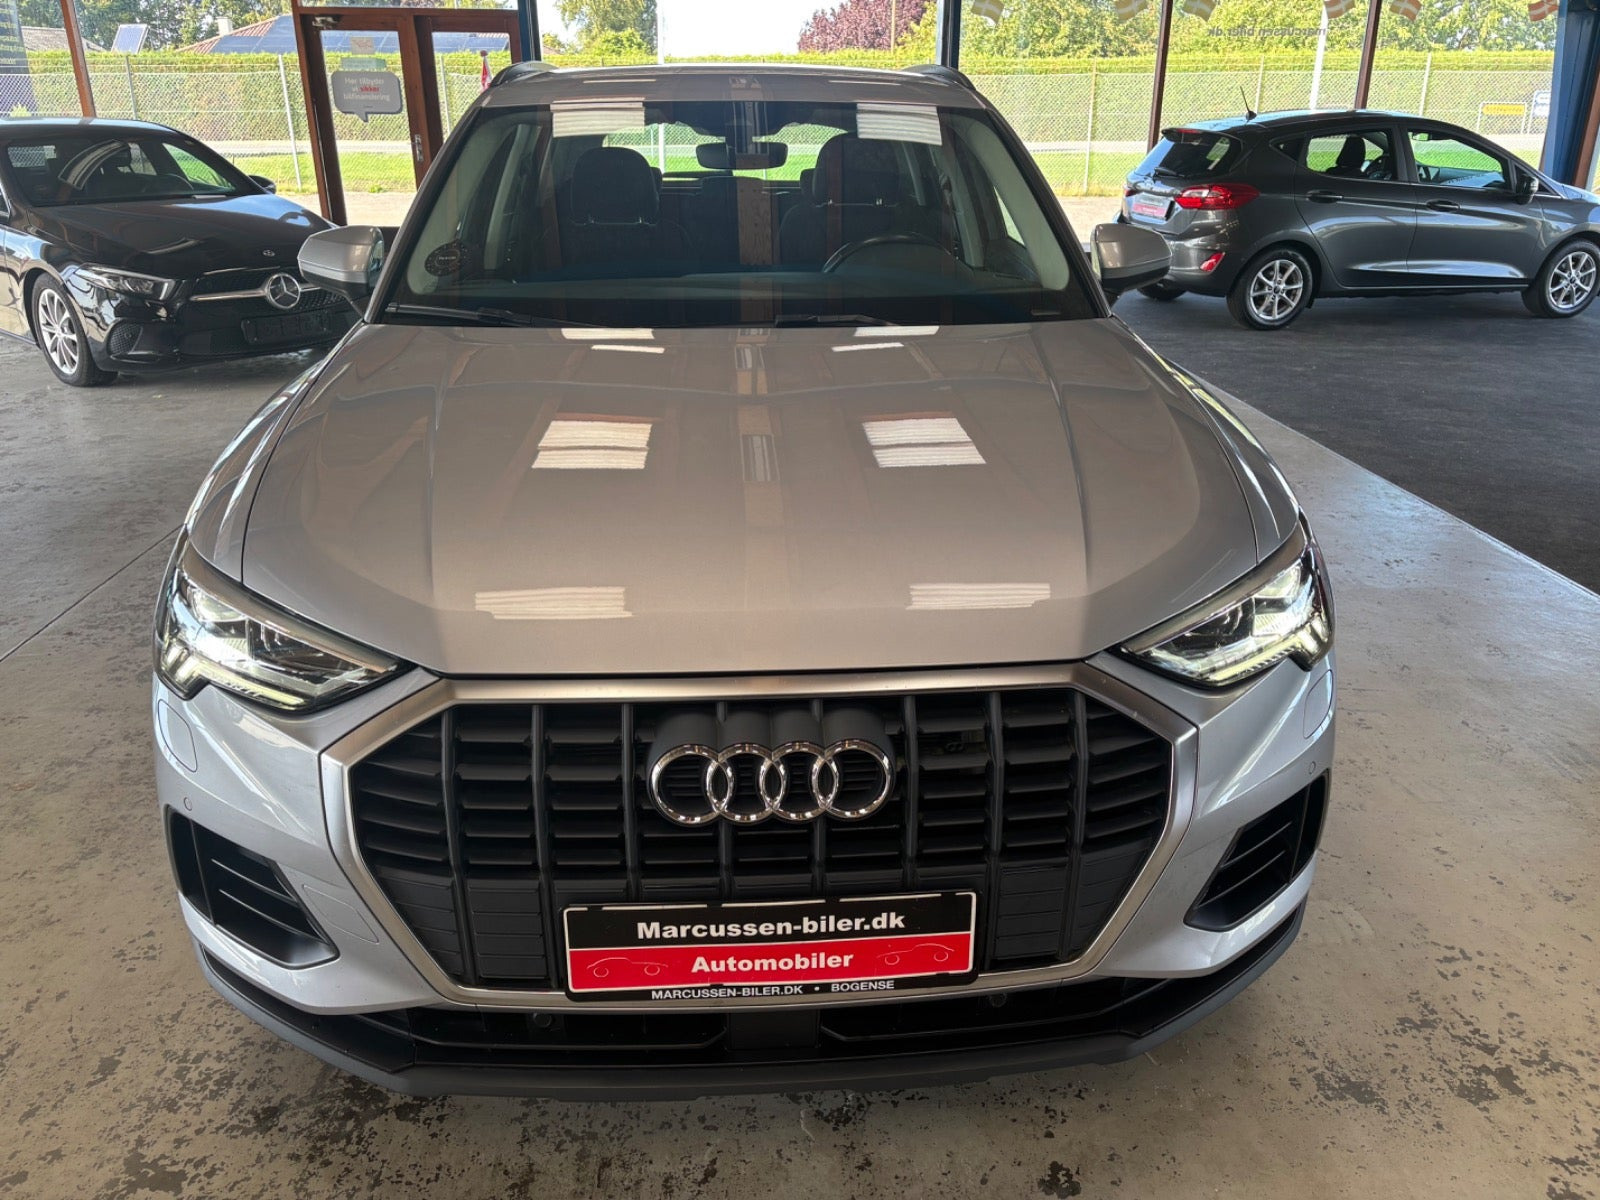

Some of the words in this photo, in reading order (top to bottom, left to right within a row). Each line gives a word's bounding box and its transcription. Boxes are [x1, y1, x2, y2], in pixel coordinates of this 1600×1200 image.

[637, 911, 906, 939] Marcussen-biler.dk
[691, 952, 854, 974] Automobiler
[651, 985, 803, 1000] MARCUSSEN-BILER.DK
[830, 980, 895, 993] BOGENSE
